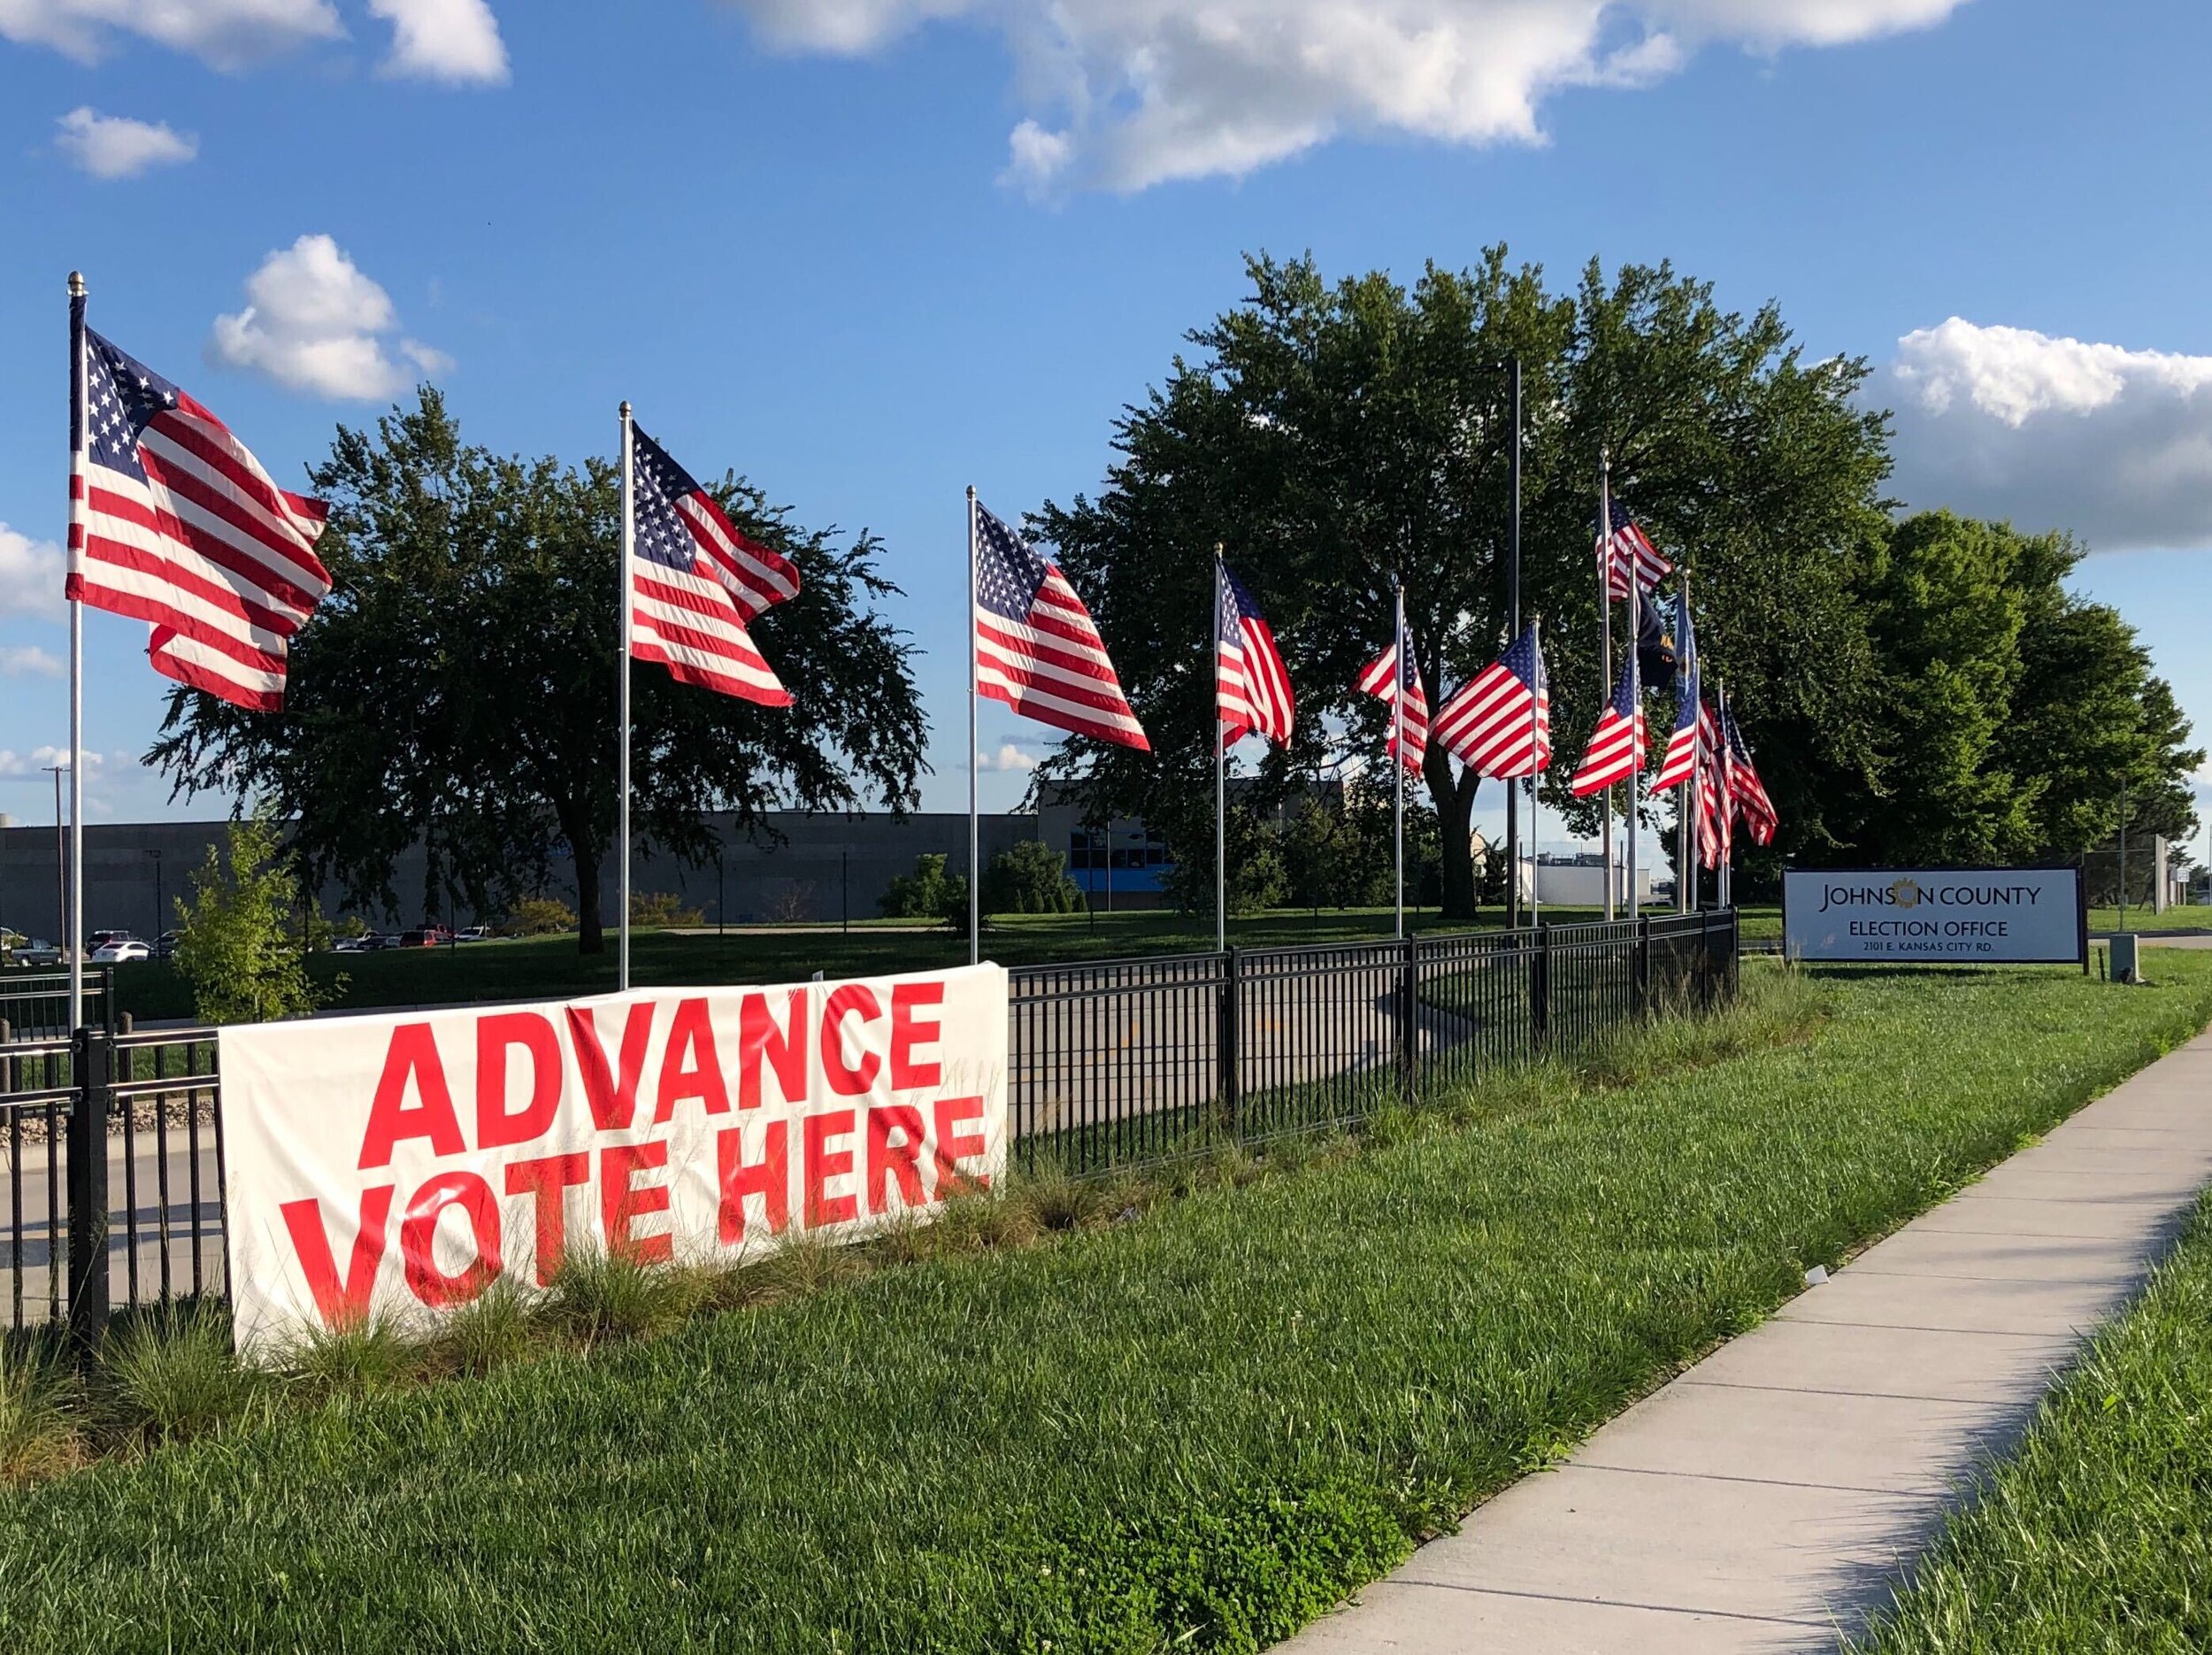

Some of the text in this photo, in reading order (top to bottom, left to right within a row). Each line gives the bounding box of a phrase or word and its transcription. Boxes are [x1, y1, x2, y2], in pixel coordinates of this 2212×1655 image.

[1819, 881, 2042, 913] JOHNSON COUNTY
[1849, 921, 2008, 936] ELECTION OFFICE
[1863, 942, 1884, 951] 2101
[1899, 942, 1943, 951] KANSAS
[1947, 942, 1973, 952] CITY
[1977, 942, 1994, 952] RD.
[358, 981, 945, 1170] ADVANCE
[280, 1095, 990, 1334] VOTE HERE
